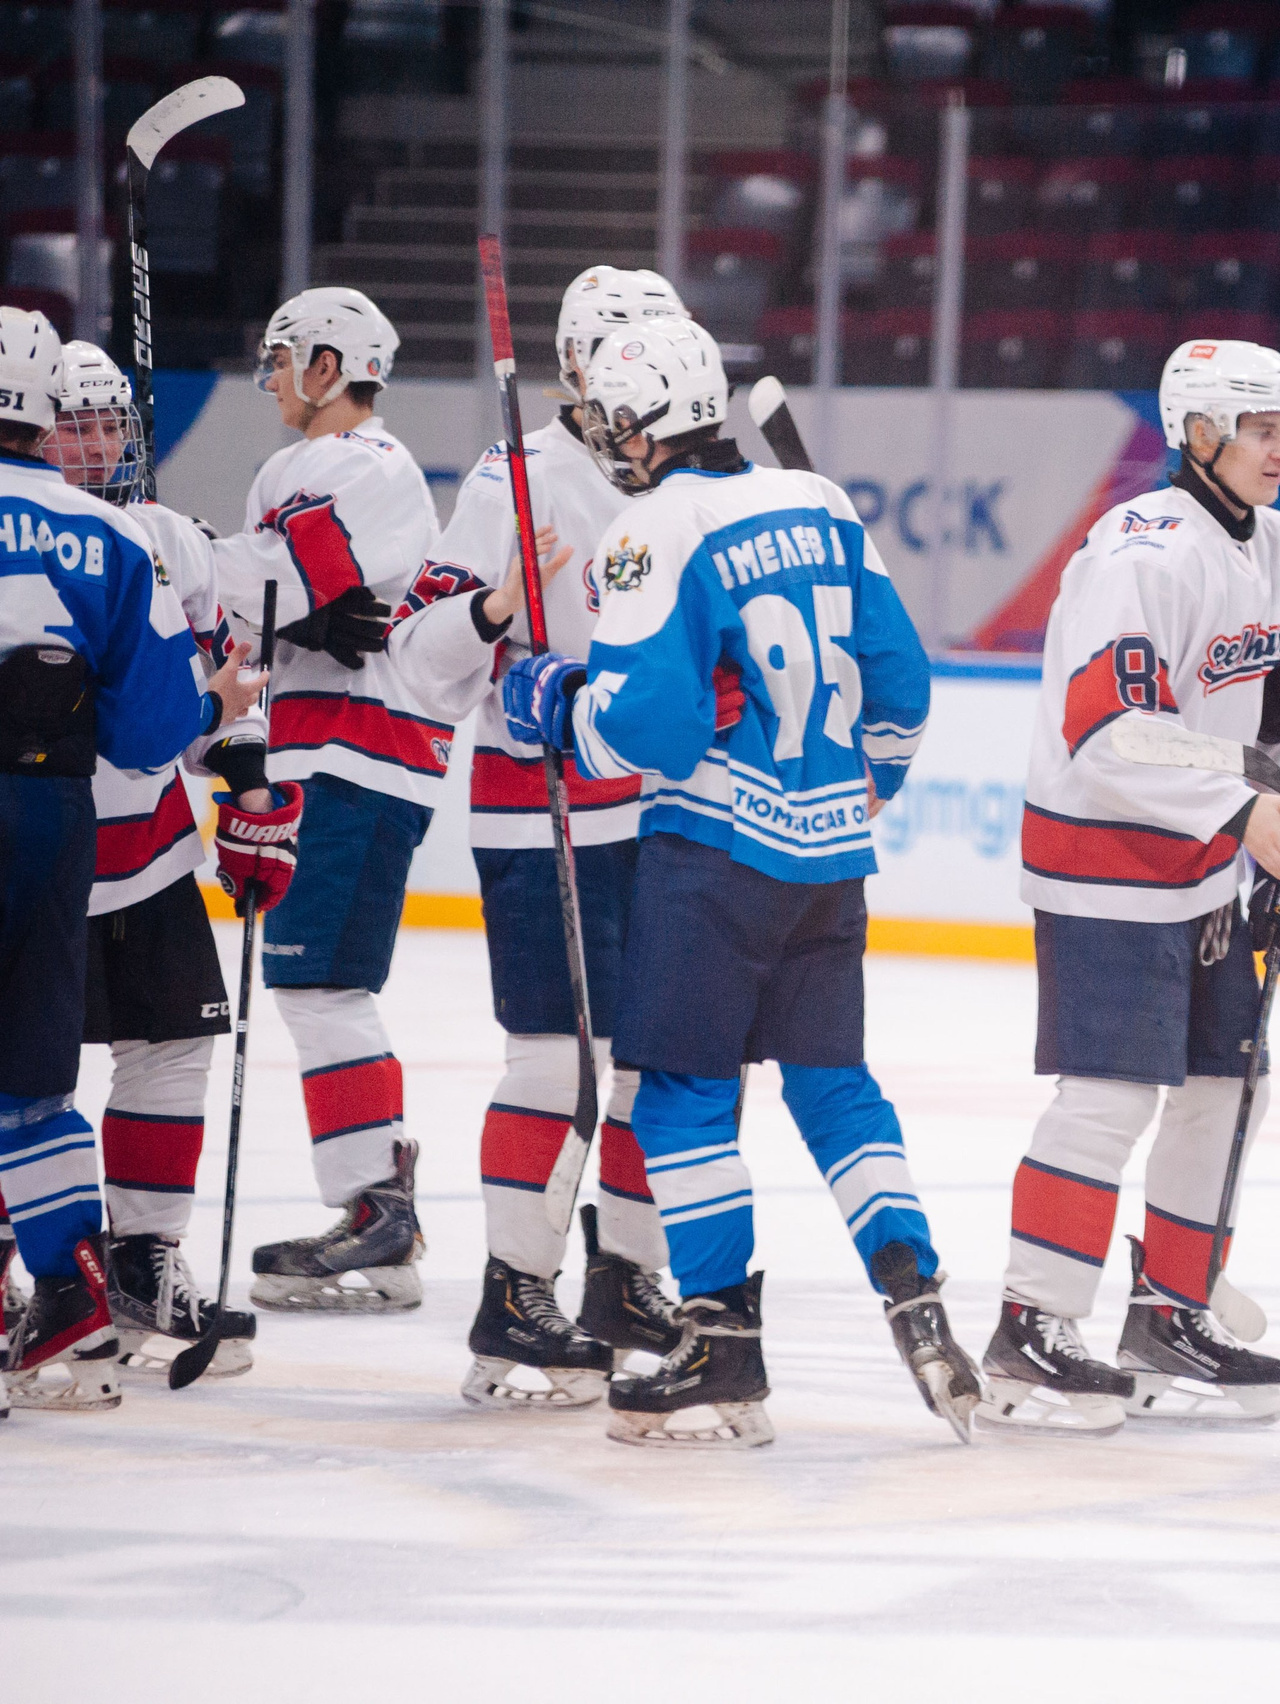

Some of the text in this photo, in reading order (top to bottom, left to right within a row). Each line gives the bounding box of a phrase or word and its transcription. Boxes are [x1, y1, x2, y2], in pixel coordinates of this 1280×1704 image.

[0, 387, 25, 412] 51
[79, 378, 114, 389] CCM
[691, 395, 717, 422] 95
[738, 584, 863, 763] 95
[1113, 633, 1160, 715] 8
[79, 1248, 106, 1285] CCM
[1172, 1339, 1222, 1371] BAUER
